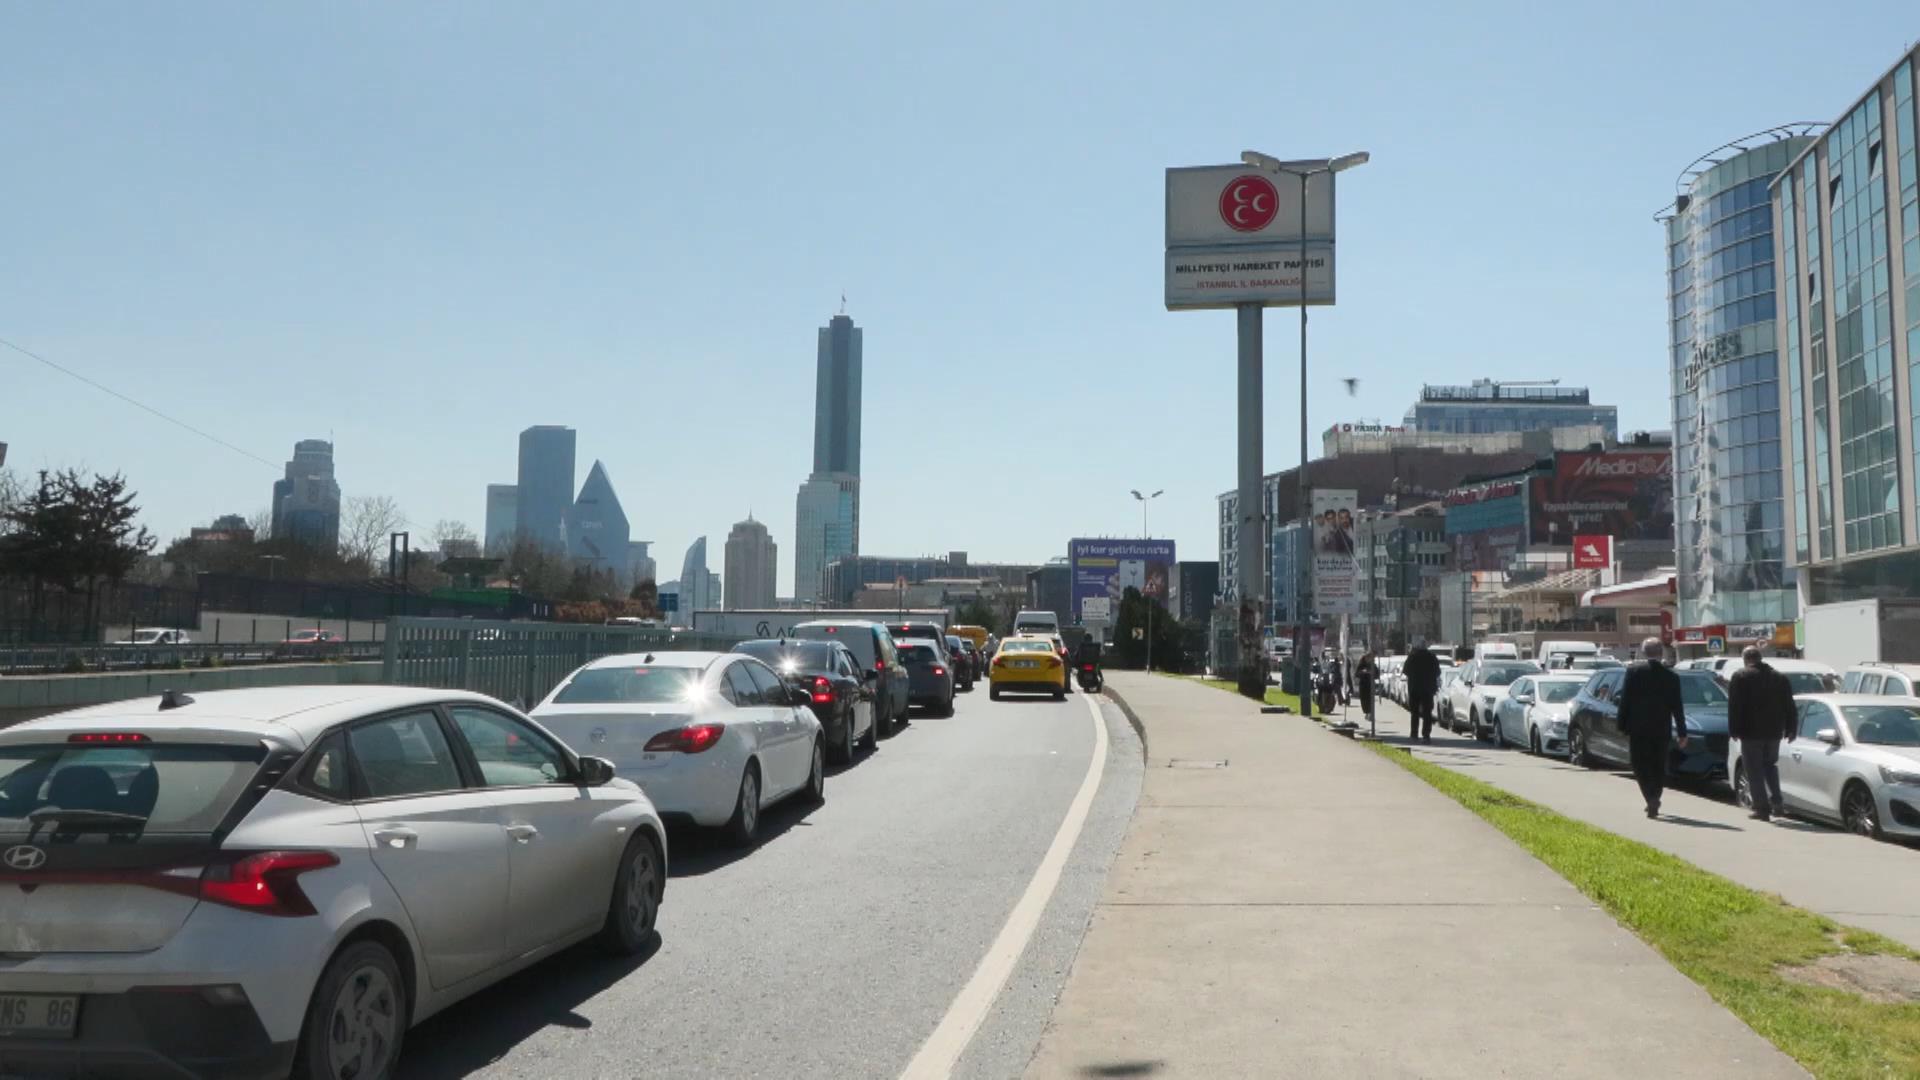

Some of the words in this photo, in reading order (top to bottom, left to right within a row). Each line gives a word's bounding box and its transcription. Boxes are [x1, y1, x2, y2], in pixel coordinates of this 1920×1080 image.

[1233, 261, 1280, 272] HAREKET
[1574, 456, 1637, 476] Media
[47, 999, 73, 1028] 86
